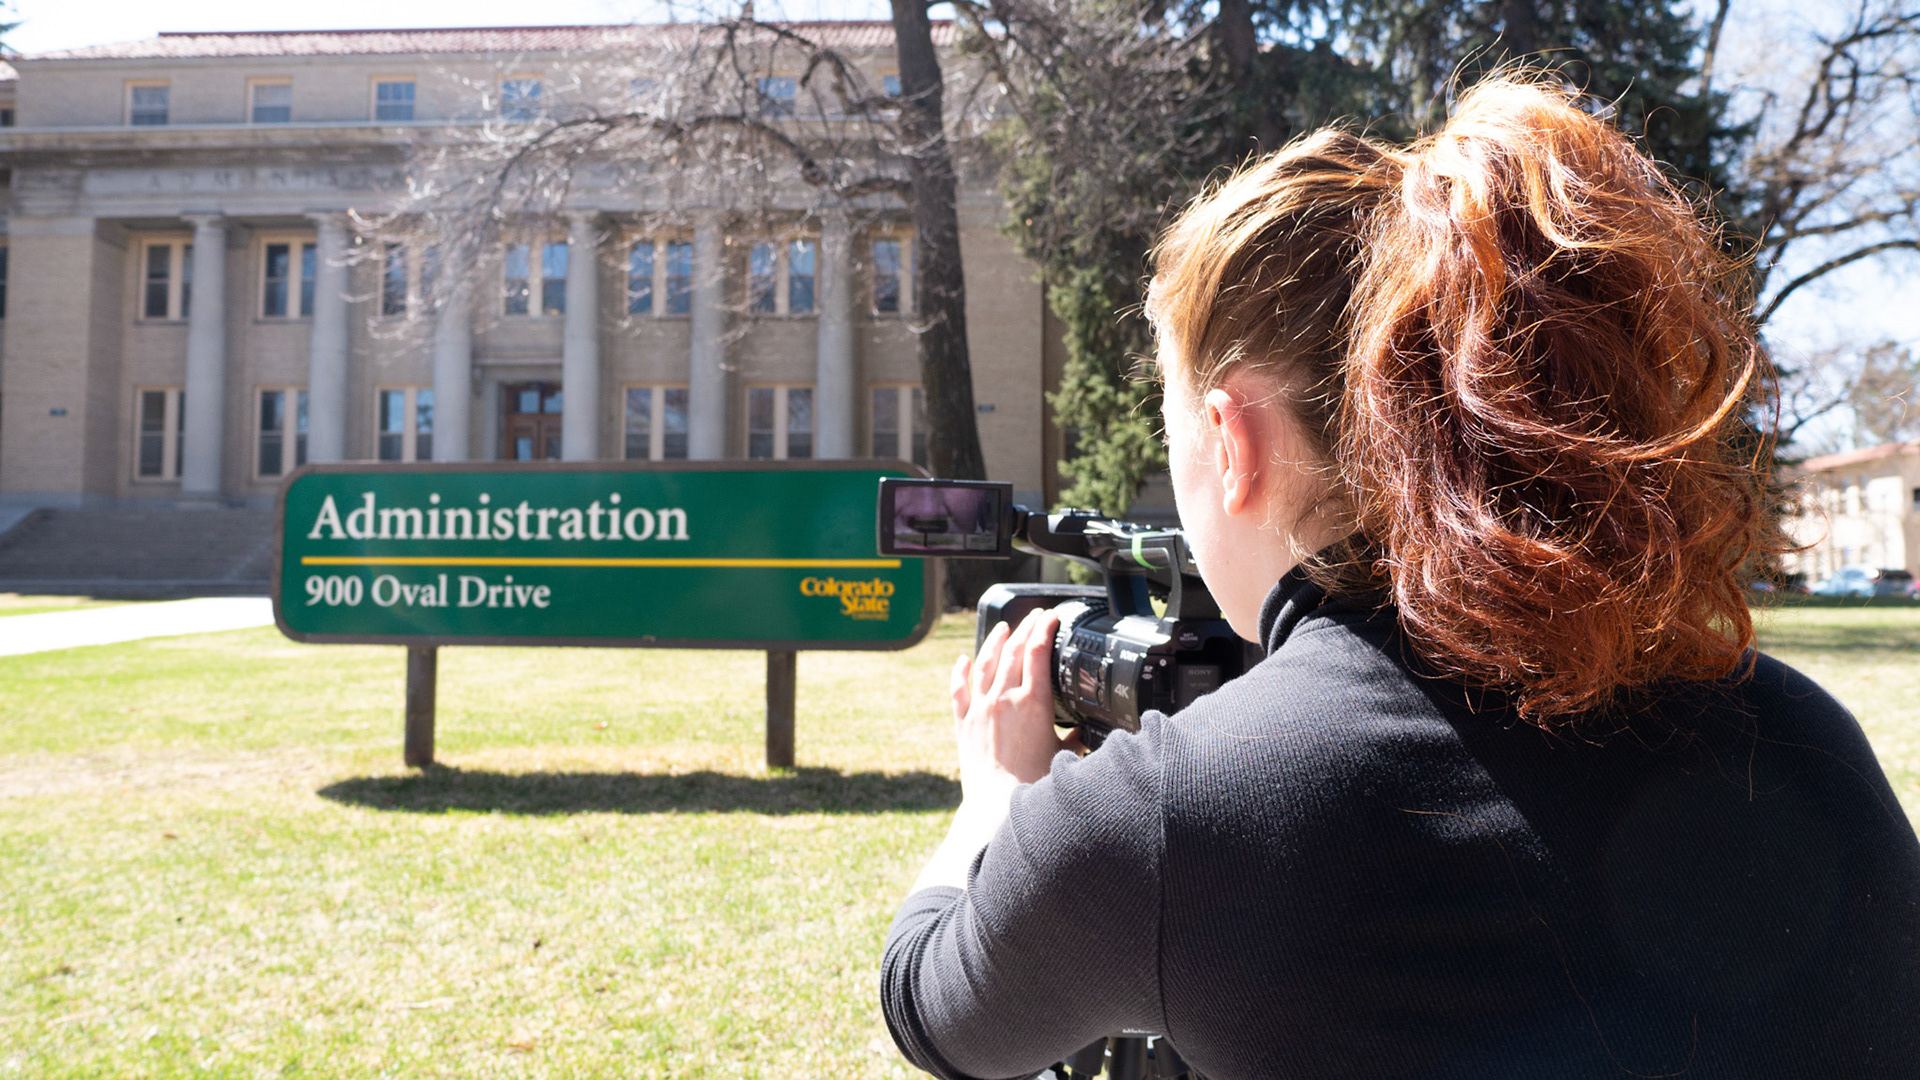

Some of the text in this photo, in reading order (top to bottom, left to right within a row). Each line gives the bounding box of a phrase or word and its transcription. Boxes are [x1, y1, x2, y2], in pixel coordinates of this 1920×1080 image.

[307, 491, 691, 541] Administration
[305, 574, 551, 609] 900 Oval Drive
[800, 577, 895, 597] Colorado
[840, 594, 890, 615] State
[1114, 683, 1130, 699] 4K
